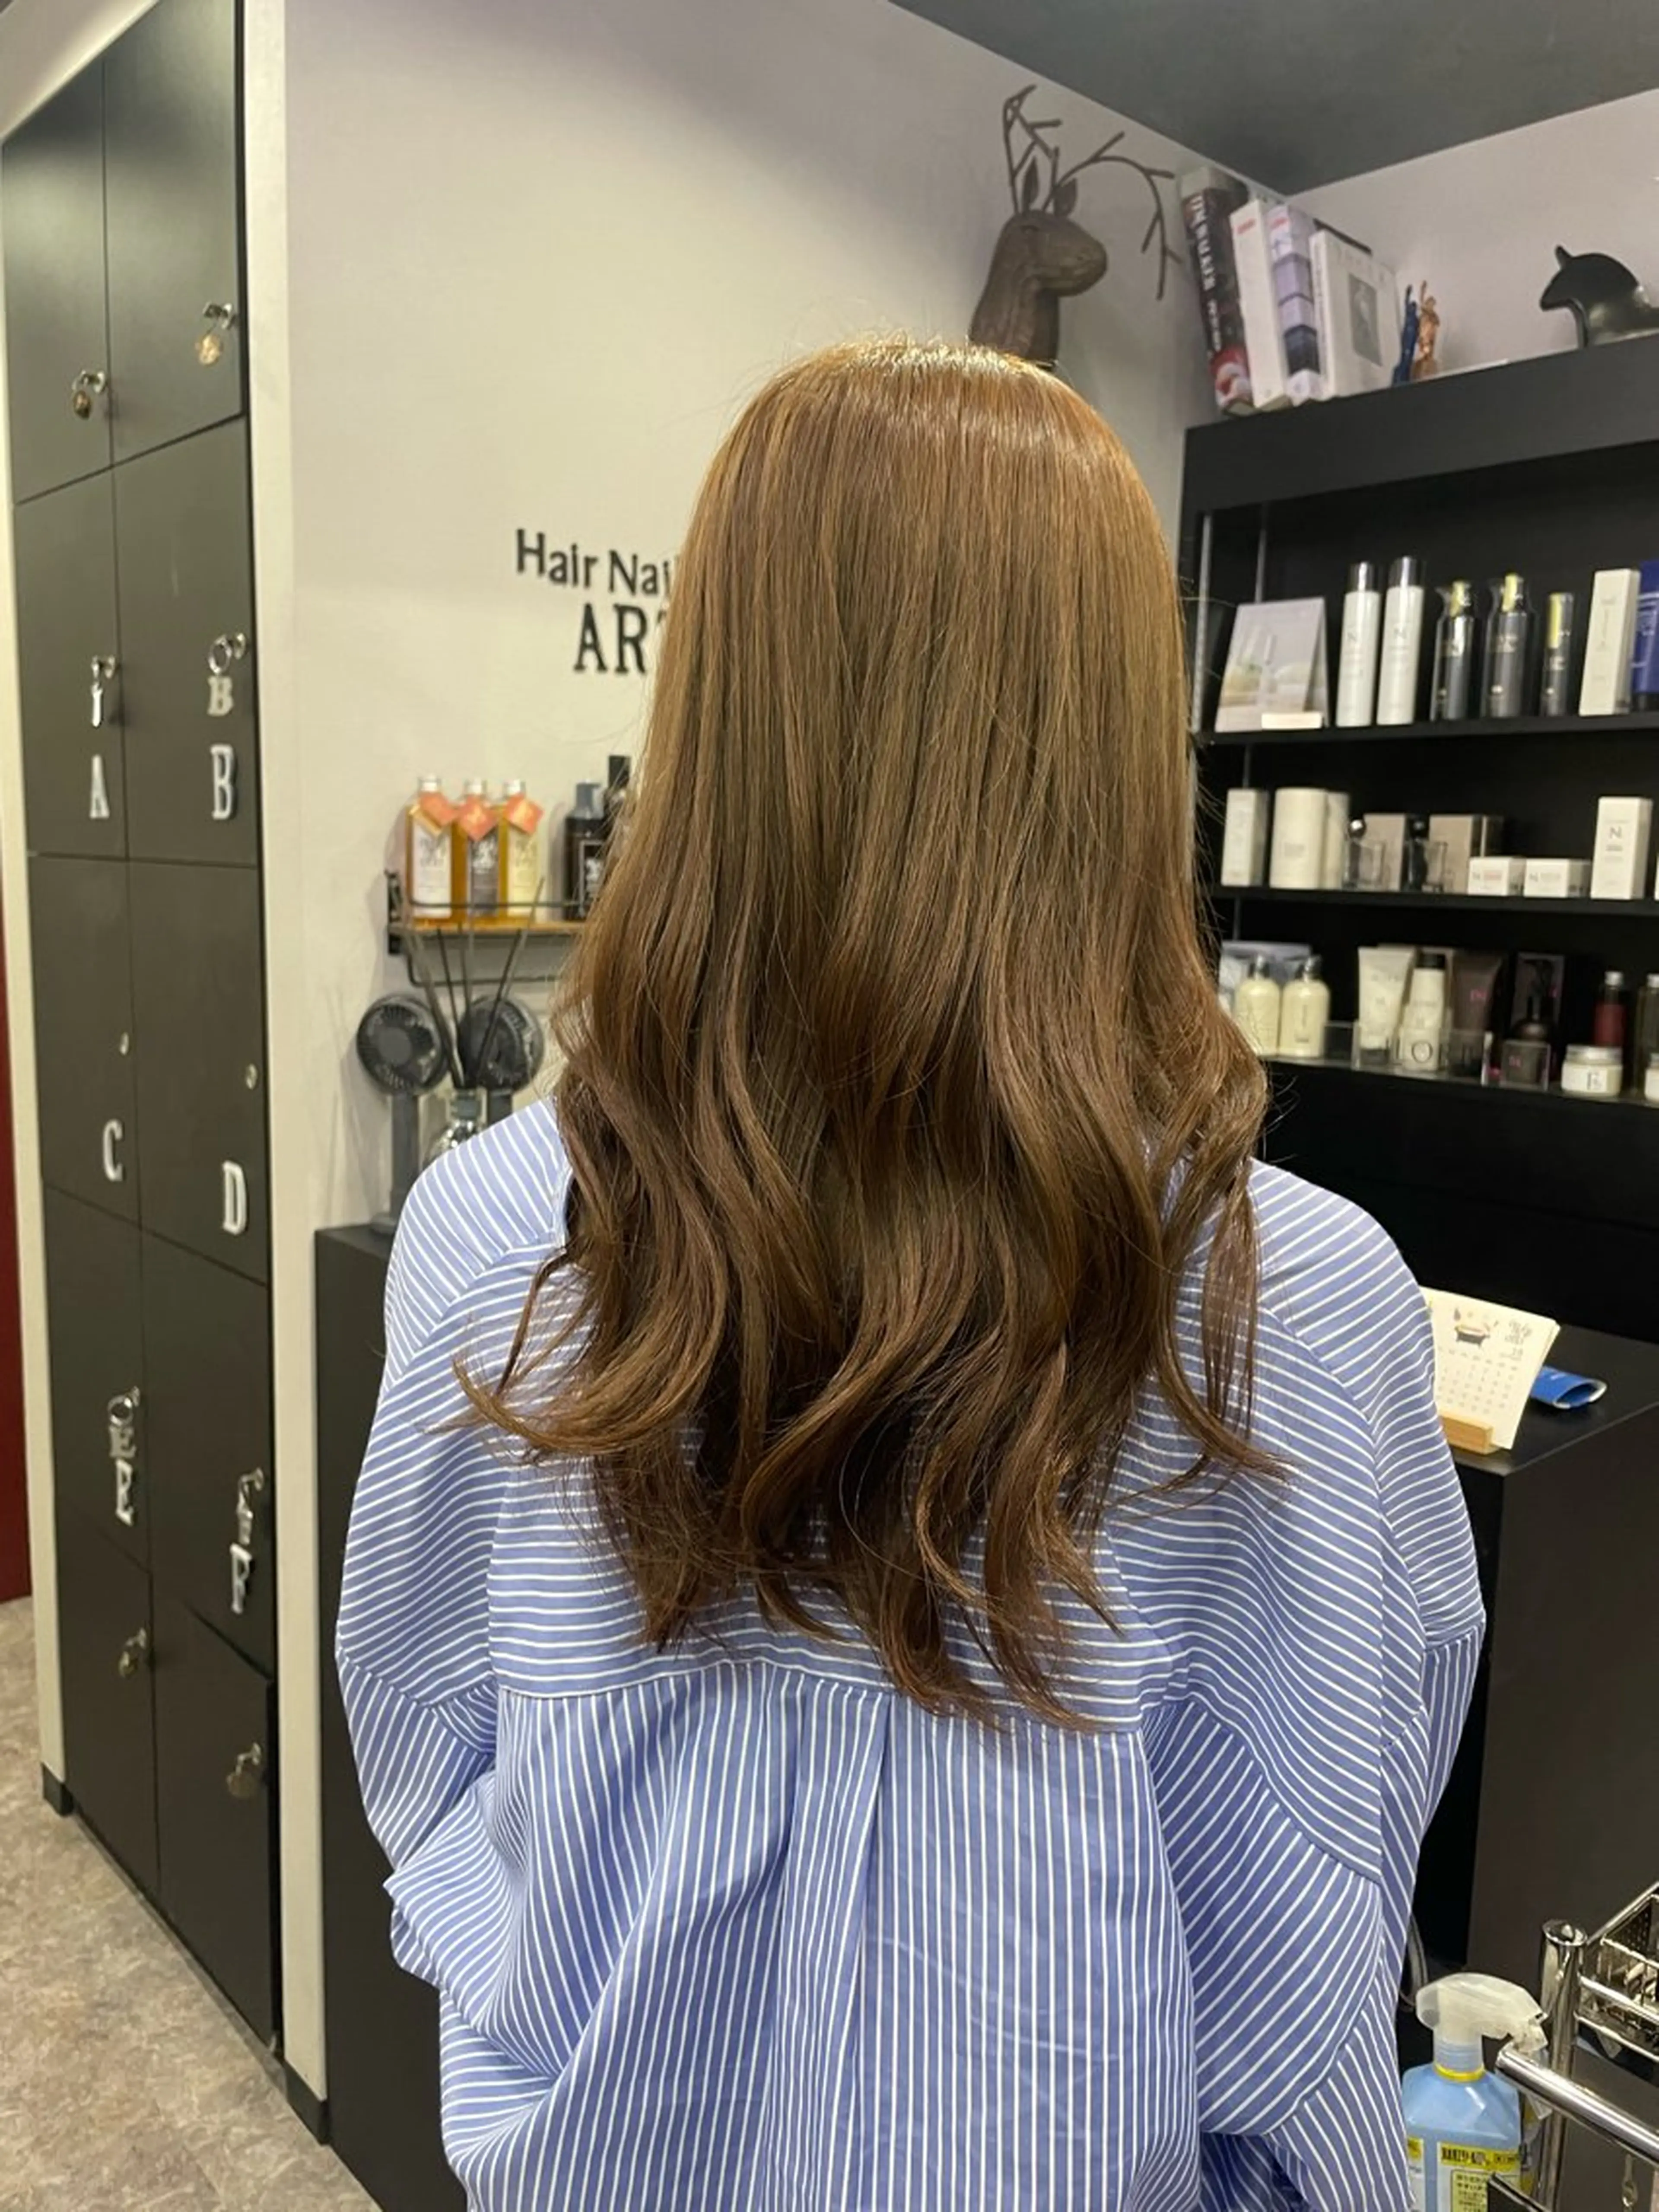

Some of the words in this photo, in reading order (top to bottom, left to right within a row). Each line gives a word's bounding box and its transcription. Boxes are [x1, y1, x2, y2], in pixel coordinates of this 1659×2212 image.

[516, 528, 599, 589] Hair
[609, 549, 673, 598] Nai
[89, 754, 110, 819] A
[210, 744, 235, 820] B
[102, 1118, 123, 1182] C
[222, 1160, 247, 1236] D
